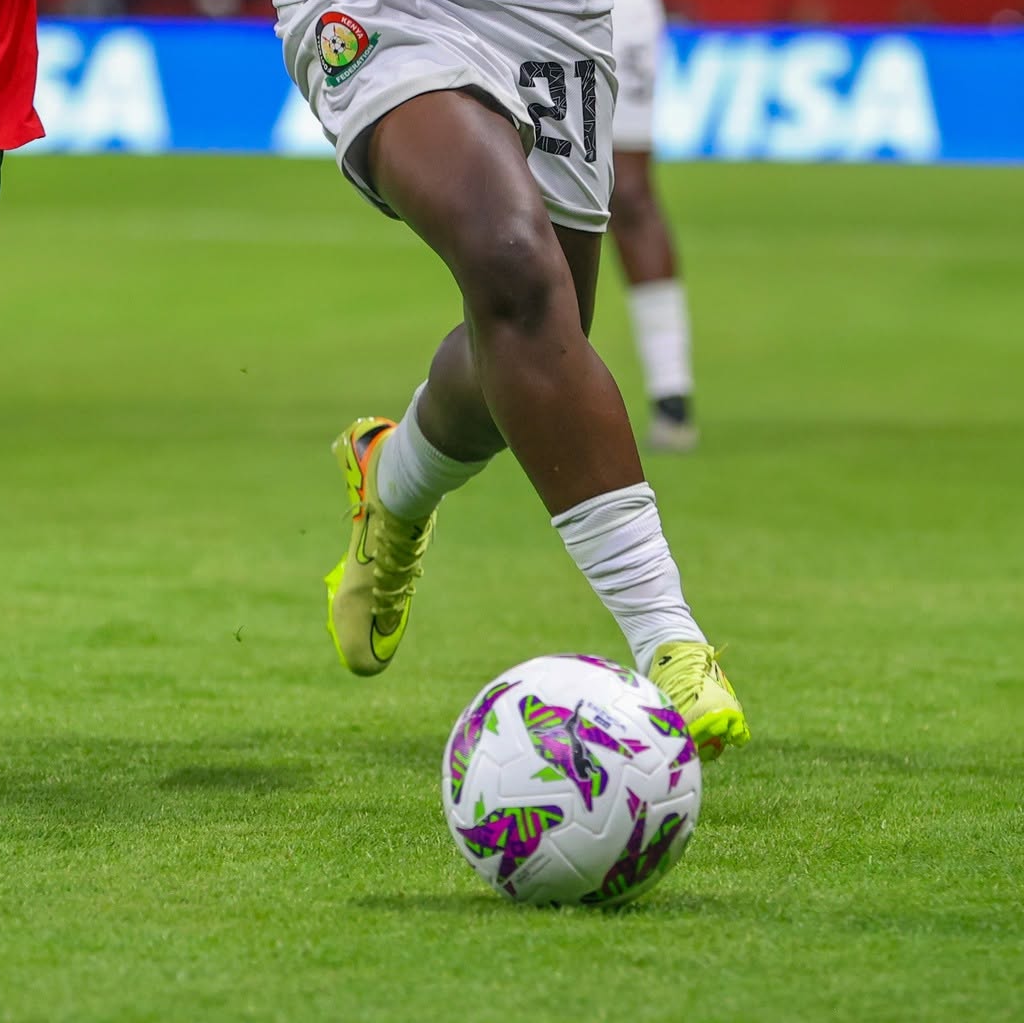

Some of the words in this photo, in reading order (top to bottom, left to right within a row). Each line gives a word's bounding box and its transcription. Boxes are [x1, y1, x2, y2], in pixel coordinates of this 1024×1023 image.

[335, 44, 374, 83] FEDERATION
[341, 16, 364, 39] KENYA
[35, 26, 171, 154] SA
[519, 59, 597, 163] 21
[654, 30, 940, 163] VISA
